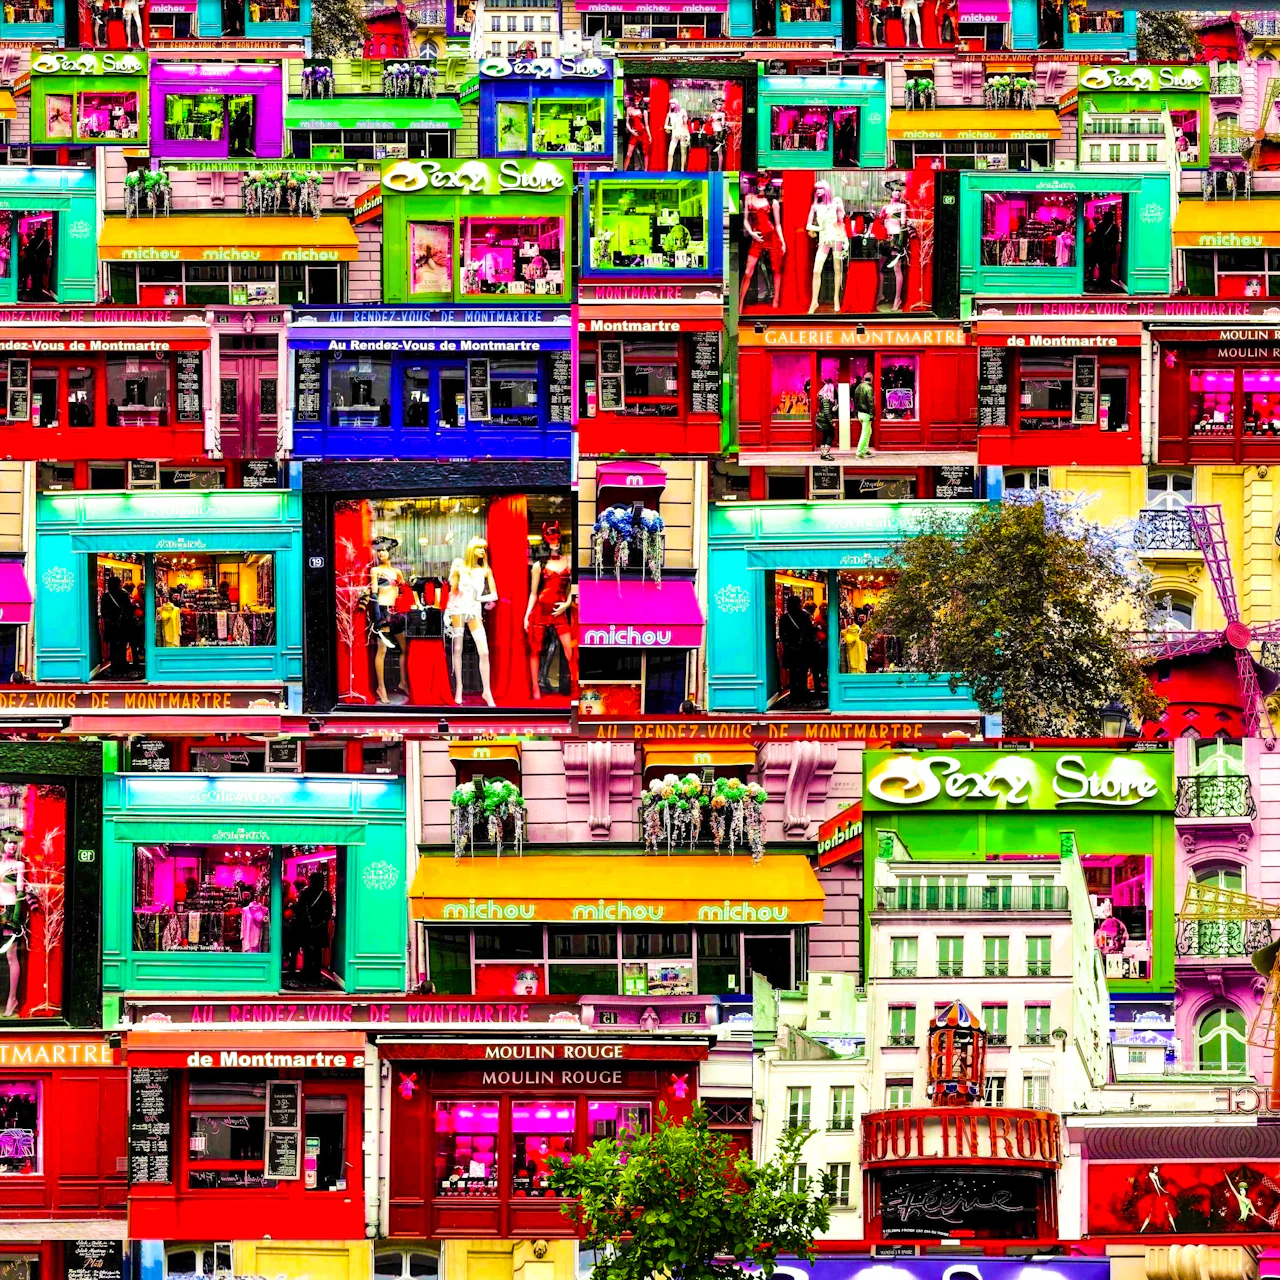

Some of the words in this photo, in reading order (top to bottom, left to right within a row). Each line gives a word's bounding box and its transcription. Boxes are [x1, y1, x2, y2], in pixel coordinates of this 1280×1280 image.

[903, 130, 942, 139] michou
[957, 130, 997, 139] michou
[1010, 130, 1049, 139] michou
[383, 161, 486, 192] Sexy
[498, 160, 564, 192] Store
[329, 310, 343, 323] AU
[354, 310, 431, 323] RENDEZ-VOUS
[441, 310, 454, 323] DE
[465, 310, 542, 323] MONTMARTRE
[765, 331, 833, 344] GALERIE
[841, 330, 966, 345] MONTMARTRE
[1220, 331, 1267, 339] MOULIN
[329, 341, 345, 349] Au
[351, 341, 434, 350] Rendez-Vous
[440, 341, 456, 350] de
[461, 341, 539, 350] Montmartre
[311, 558, 321, 567] 19
[91, 692, 109, 709] DE
[124, 692, 232, 709] MONTMARTRE
[443, 899, 536, 920] michou
[572, 900, 665, 920] michou
[698, 900, 789, 921] michou
[486, 1047, 554, 1058] MOULIN
[565, 1046, 622, 1058] ROUGE
